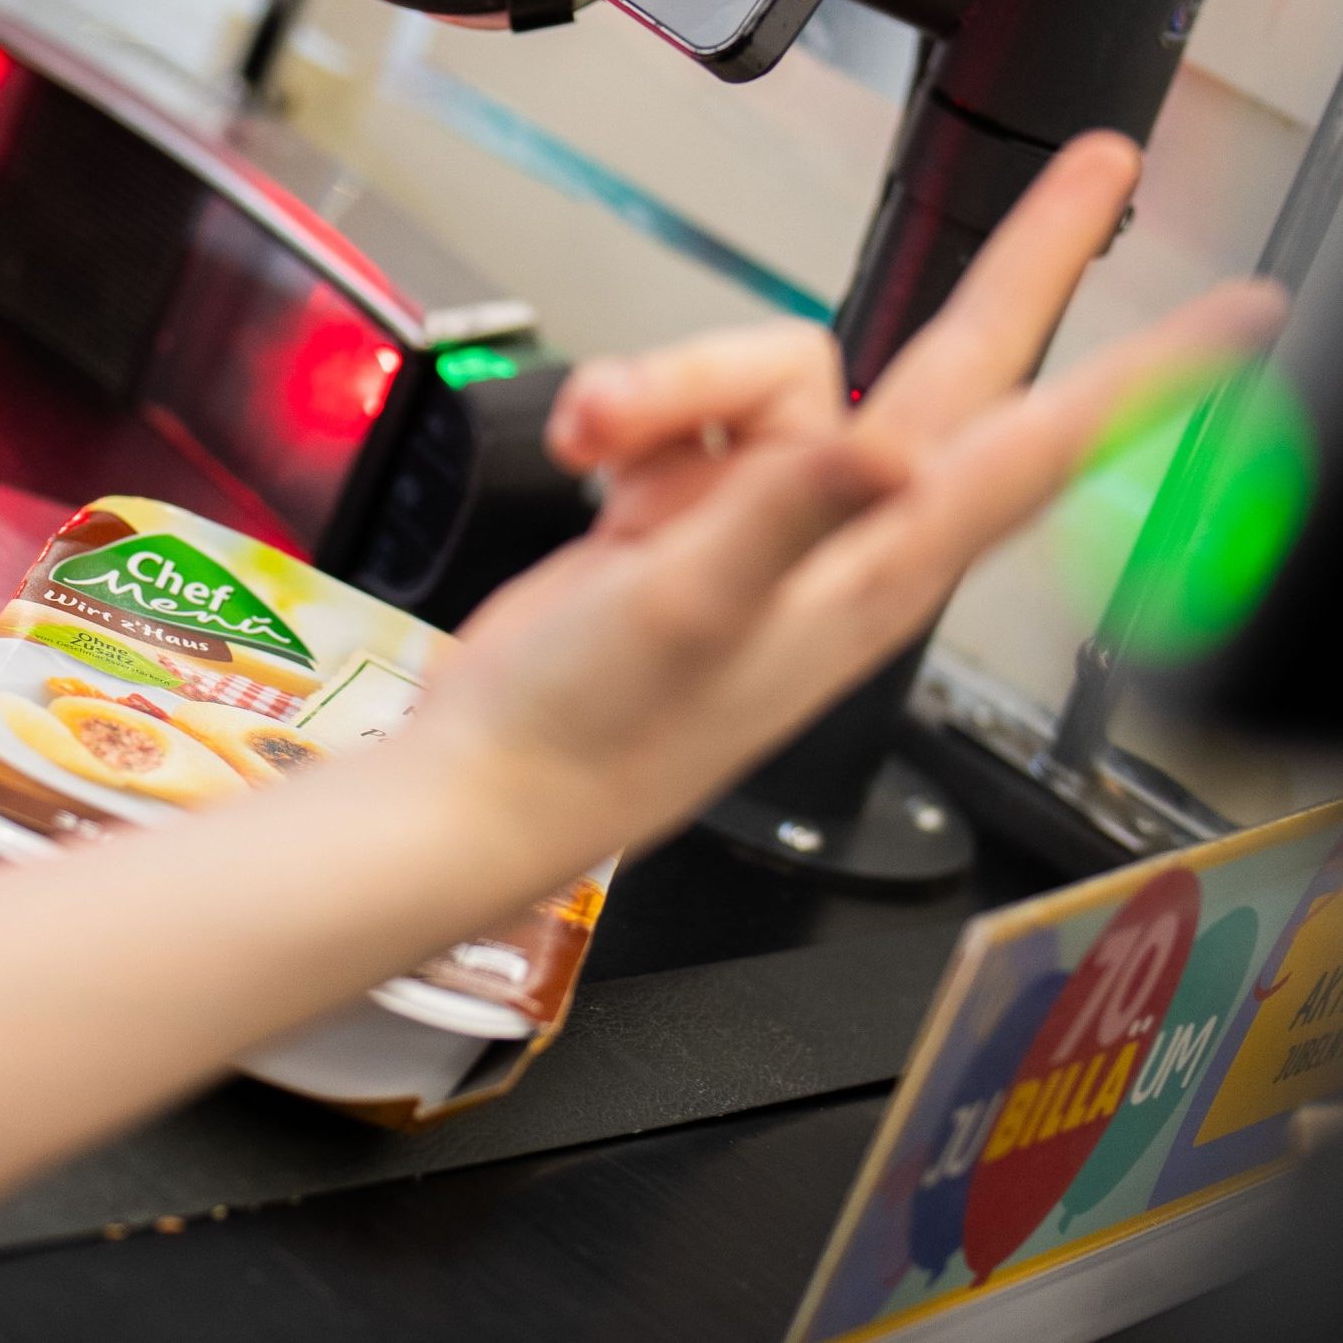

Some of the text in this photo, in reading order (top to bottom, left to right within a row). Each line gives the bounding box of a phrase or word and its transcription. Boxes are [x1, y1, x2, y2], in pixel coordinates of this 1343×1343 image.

[126, 551, 234, 611] Chef
[43, 589, 210, 652] Wirt z'Haus
[78, 632, 129, 657] Ohne
[69, 636, 135, 666] Zusatz
[1050, 912, 1181, 1062] 70
